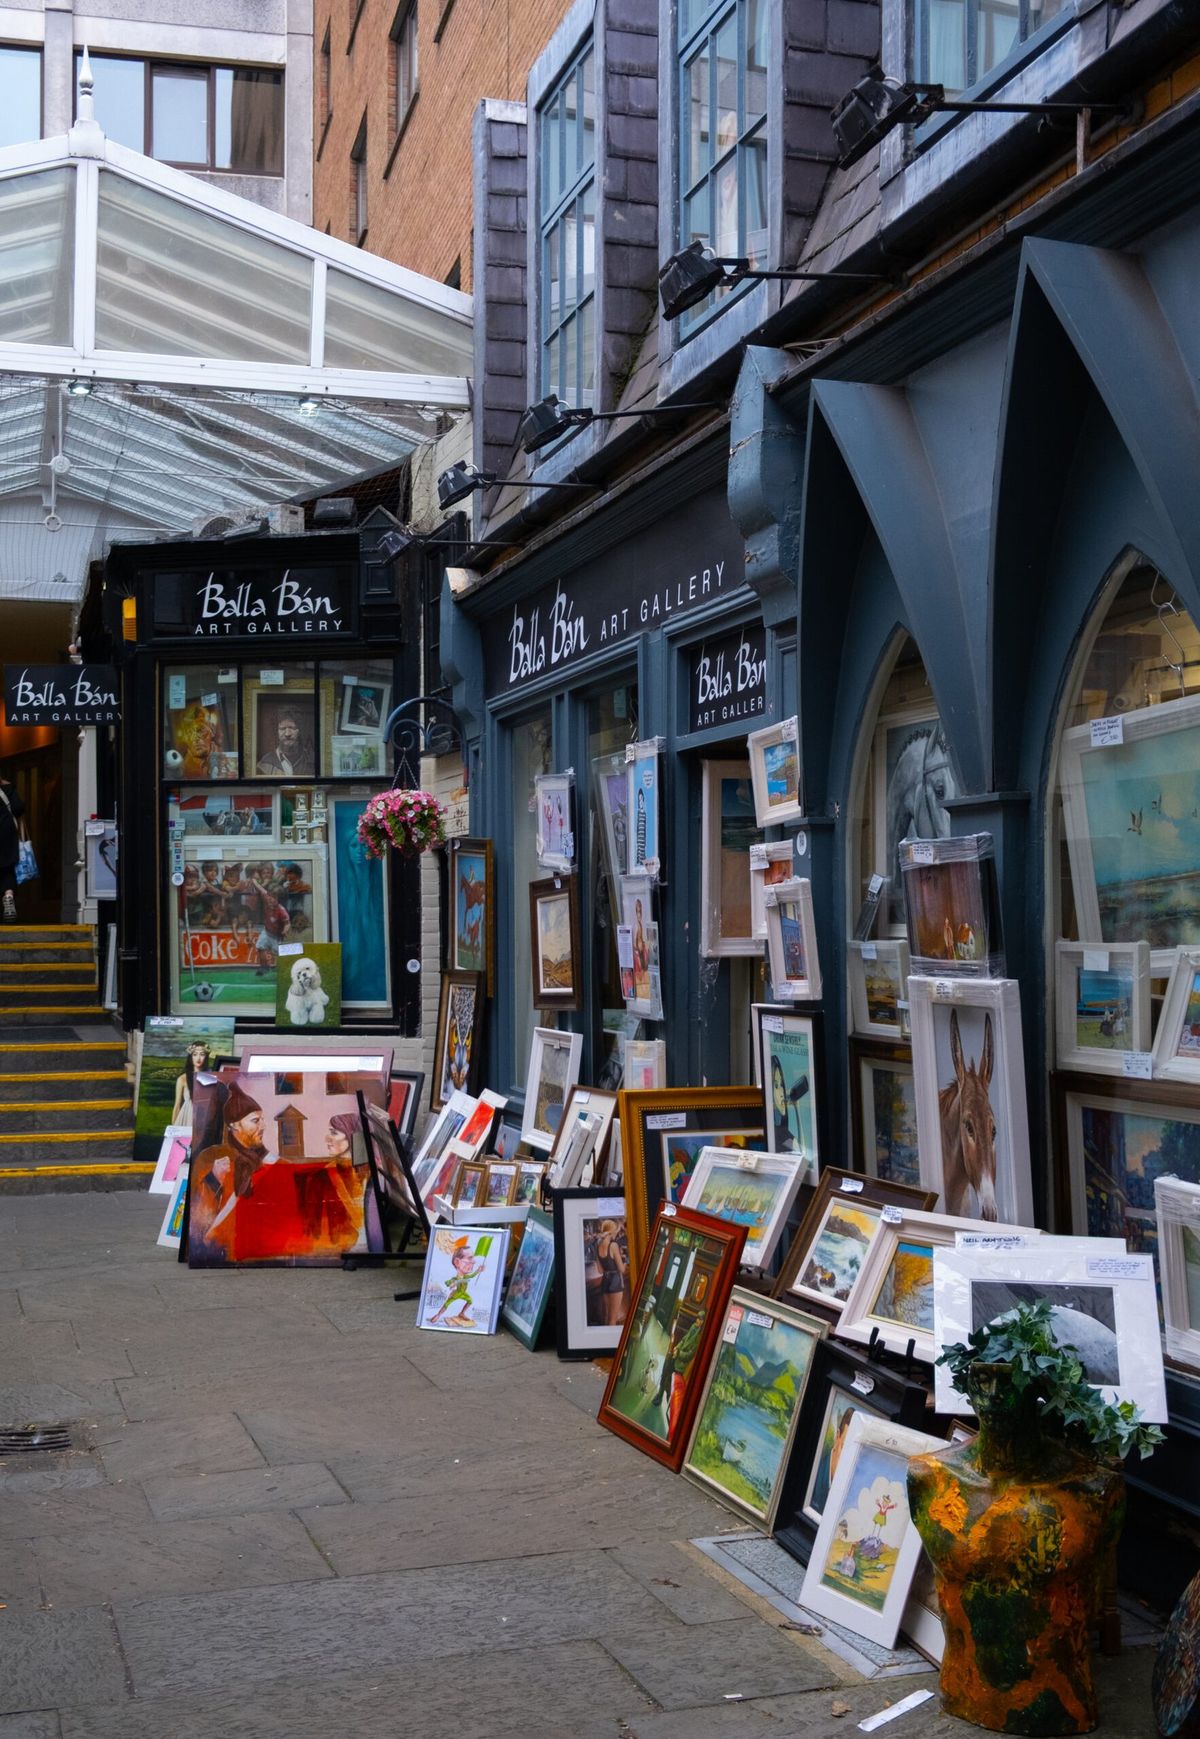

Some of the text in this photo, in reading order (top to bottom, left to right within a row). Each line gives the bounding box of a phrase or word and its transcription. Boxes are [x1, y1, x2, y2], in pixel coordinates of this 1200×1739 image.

[197, 569, 340, 618] Balla Bán
[195, 619, 343, 635] ART GALLERY
[508, 561, 724, 683] Balla Bán ART GALLERY
[12, 668, 120, 707] Balla Bán
[695, 645, 732, 704] Balla
[11, 713, 40, 722] ART
[697, 709, 716, 726] ART
[186, 934, 239, 960] Coke
